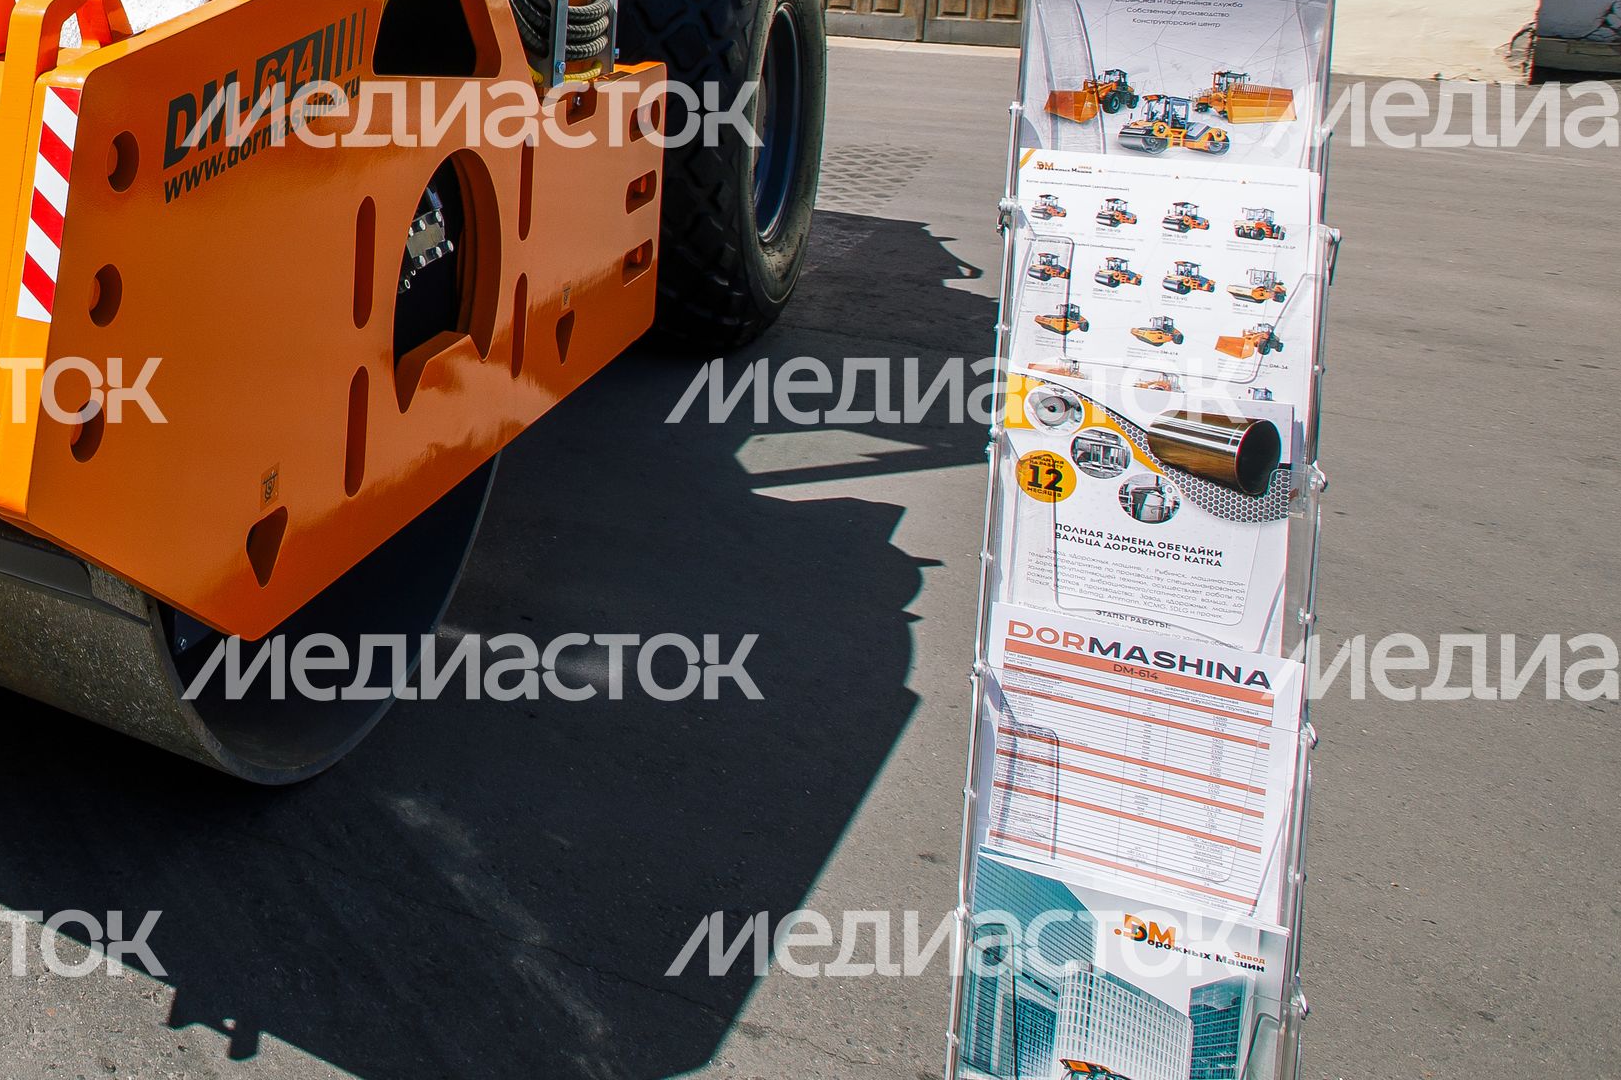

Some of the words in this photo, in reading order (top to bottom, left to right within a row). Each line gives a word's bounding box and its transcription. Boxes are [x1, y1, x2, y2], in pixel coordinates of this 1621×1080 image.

[1126, 7, 1176, 15] Собственное
[1178, 10, 1230, 18] производство
[1163, 0, 1212, 7] гарантийная
[1213, 1, 1243, 9] служба
[1132, 18, 1197, 27] Конструкторский
[1198, 21, 1221, 29] центр
[163, 30, 323, 170] DM-614
[1027, 465, 1063, 492] 12
[1027, 487, 1062, 498] МЕСЯЦВ
[1055, 523, 1103, 539] ПОЛНАЯ
[1106, 532, 1154, 548] ЗАМЕНА
[1157, 541, 1223, 558] ОБЕЧАЙКИ
[1055, 531, 1101, 547] ВАЛЬЦА
[1104, 541, 1181, 561] ДОРОЖНОГО
[1184, 555, 1222, 568] КАТКА
[1095, 609, 1128, 623] ЭТАПЫ
[1130, 616, 1172, 630] РАБОТЫ:
[1008, 620, 1273, 690] DORMASHINA
[1113, 663, 1160, 681] DM-614
[1133, 926, 1211, 961] Дорожных
[1215, 953, 1265, 973] Машин
[1234, 951, 1266, 965] Завод
